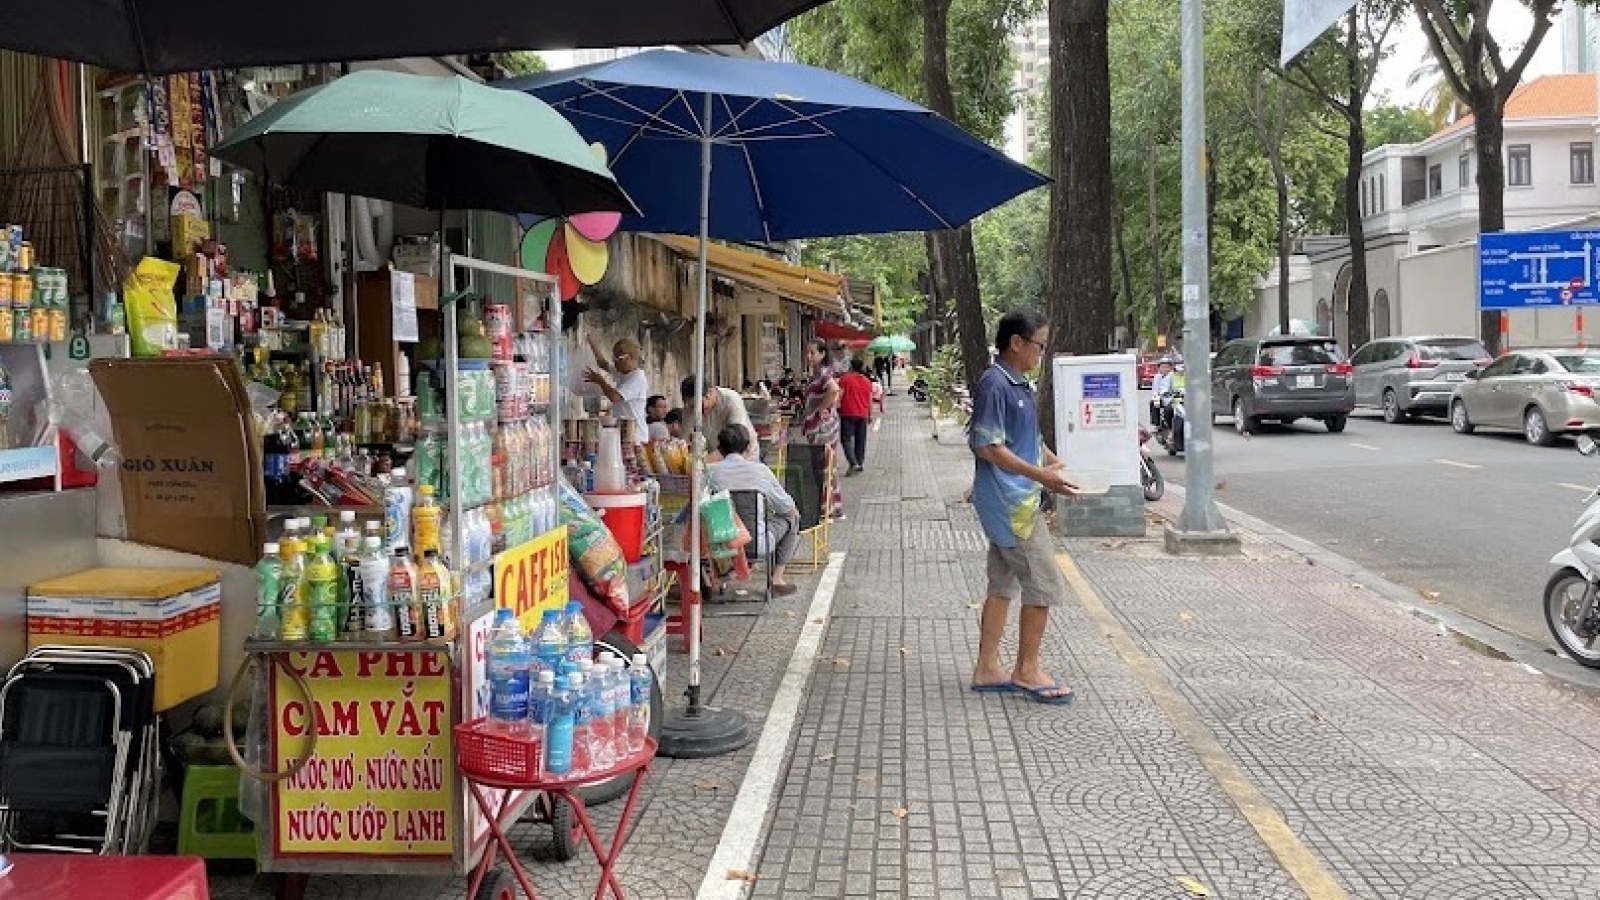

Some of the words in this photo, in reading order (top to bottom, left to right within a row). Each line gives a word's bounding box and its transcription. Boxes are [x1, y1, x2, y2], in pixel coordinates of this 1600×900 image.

[500, 547, 548, 618] CAFE
[282, 701, 360, 736] CAM
[370, 681, 445, 736] VẮT
[366, 748, 408, 790] NƯỚC
[287, 802, 342, 842] NƯỚC
[347, 802, 388, 842] ƯỚP
[393, 810, 447, 849] LẠNH
